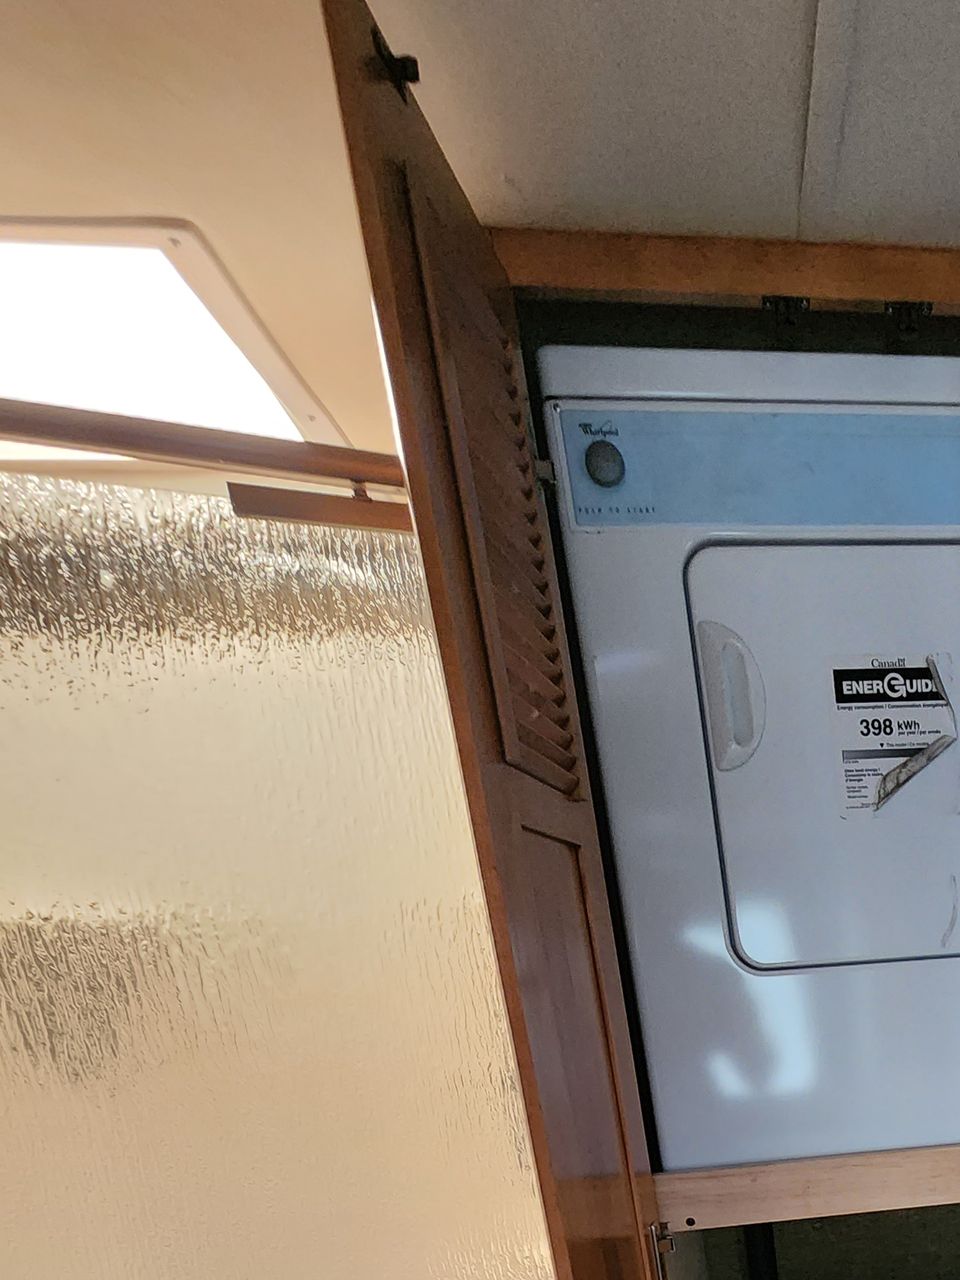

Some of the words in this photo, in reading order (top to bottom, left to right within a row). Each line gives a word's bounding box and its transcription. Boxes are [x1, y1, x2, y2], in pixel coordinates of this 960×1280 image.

[871, 658, 906, 668] Canada
[860, 718, 894, 737] 398
[897, 720, 920, 731] kWh
